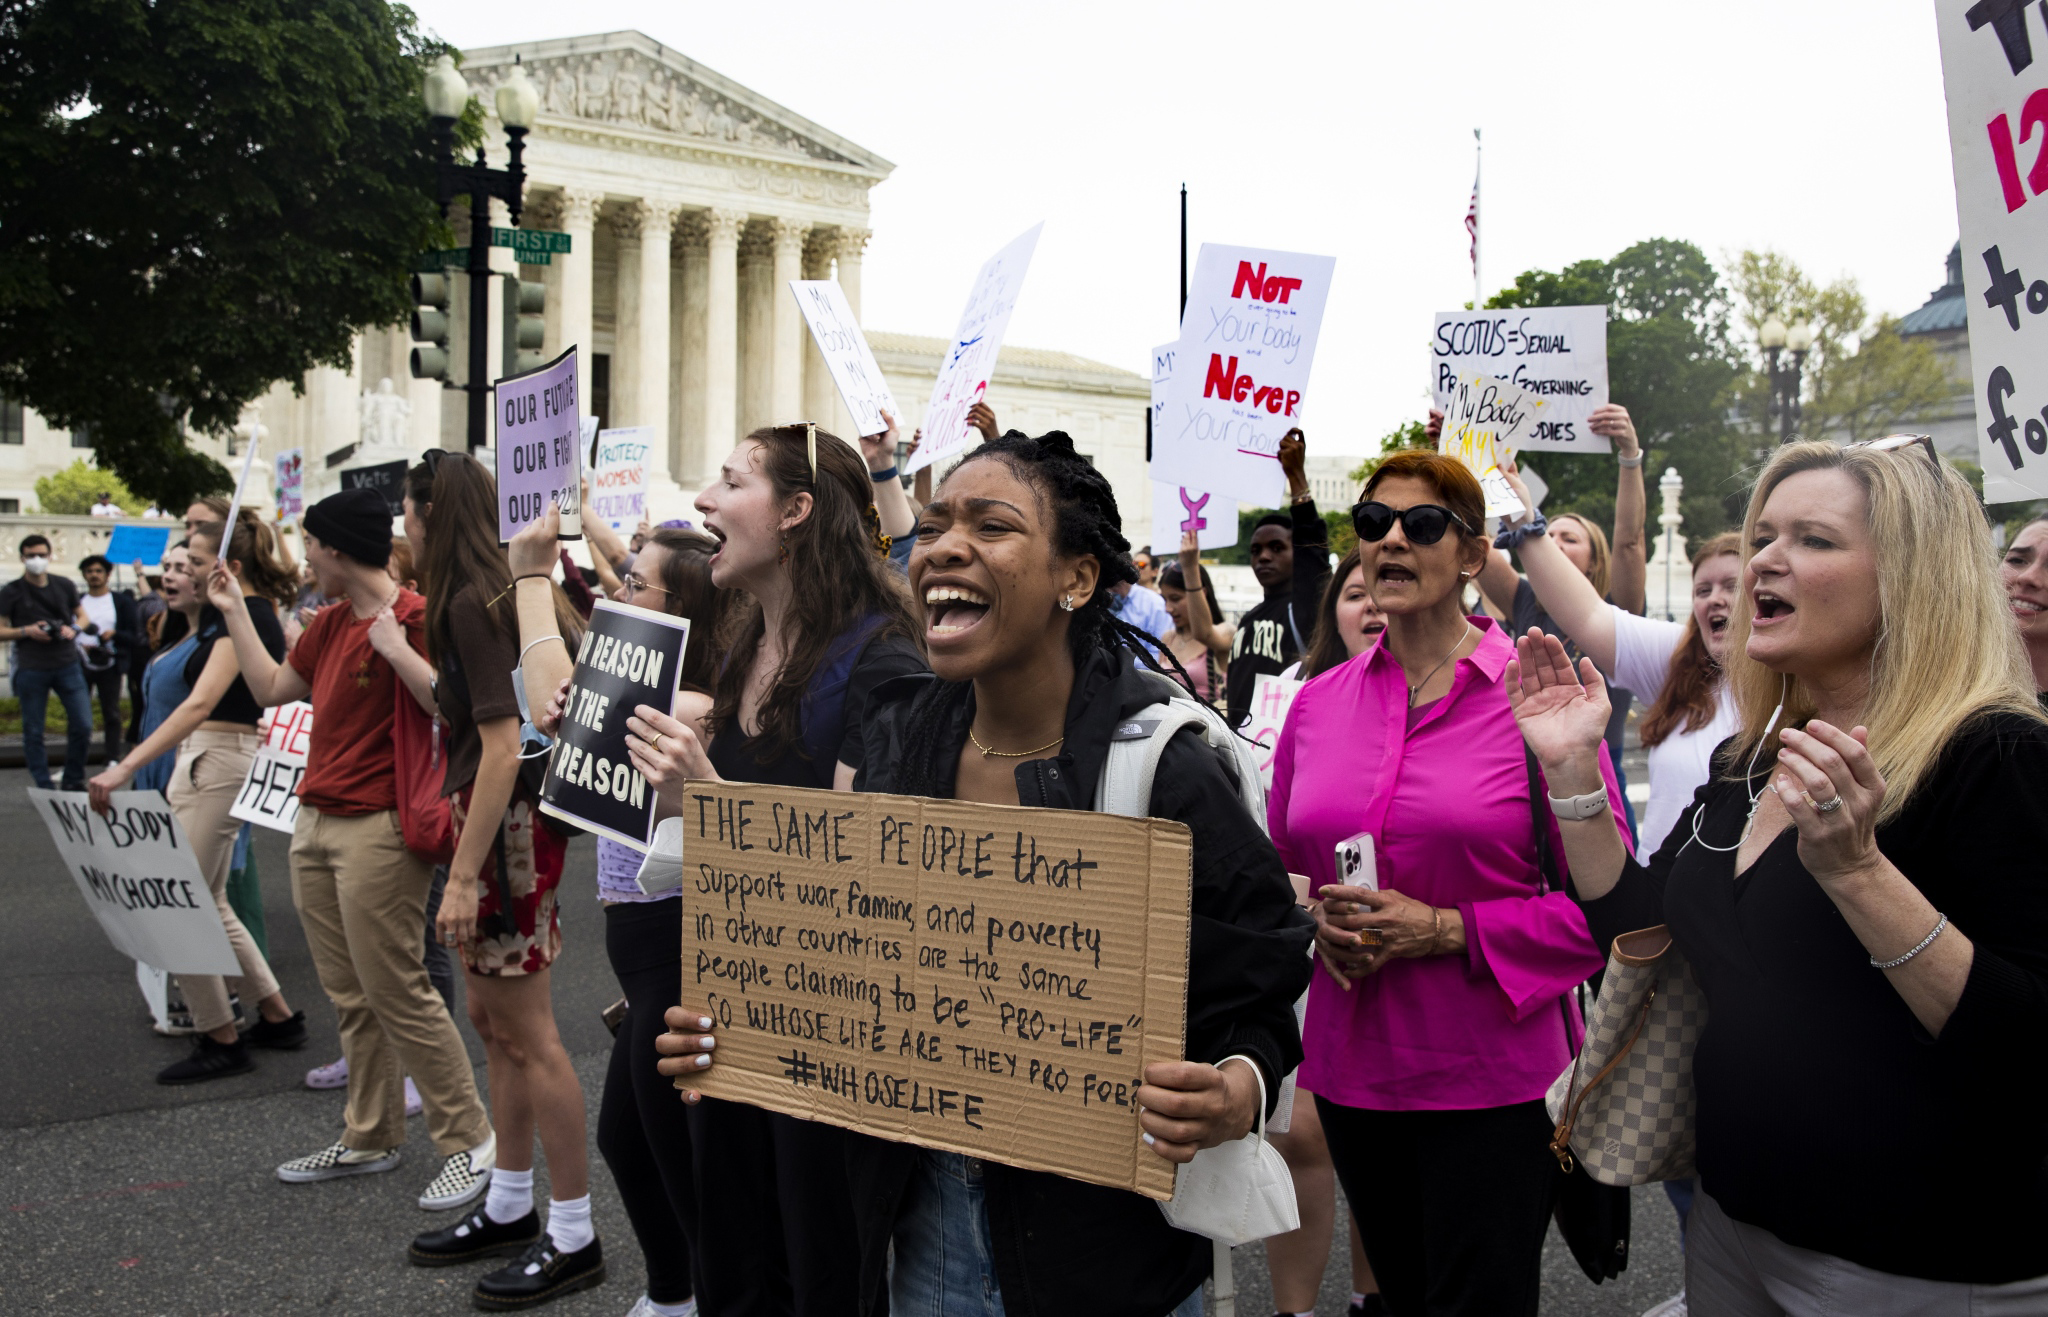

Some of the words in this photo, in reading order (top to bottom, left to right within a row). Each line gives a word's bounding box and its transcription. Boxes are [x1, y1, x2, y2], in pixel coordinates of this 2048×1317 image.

[497, 230, 553, 249] FIRST
[514, 252, 549, 263] UNIT
[1982, 244, 2048, 332] to
[1261, 315, 1301, 365] body
[505, 393, 537, 427] OUR
[544, 374, 574, 418] FUTURE
[1475, 385, 1525, 442] Body
[513, 441, 547, 474] OUR
[599, 442, 649, 467] PROTECT
[1237, 422, 1281, 454] Choic
[508, 492, 542, 523] OUR
[589, 633, 664, 689] REASON
[575, 688, 610, 733] THE
[555, 742, 646, 810] REASON
[49, 798, 94, 846] MY
[102, 805, 177, 849] BODY
[691, 794, 754, 851] THE
[768, 802, 855, 864] SAME
[880, 815, 994, 878] PEOPLE
[1011, 831, 1098, 890] that
[112, 873, 200, 911] CHOICE
[695, 905, 714, 941] in
[725, 911, 786, 948] other
[797, 927, 902, 961] countries
[919, 945, 947, 968] are
[959, 947, 1000, 982] the
[1019, 962, 1092, 1000] same
[797, 883, 841, 918] war,
[926, 901, 975, 934] and
[987, 917, 1101, 969] poverty
[890, 974, 916, 1012] to
[933, 984, 970, 1028] be
[707, 992, 732, 1029] SO
[746, 1000, 833, 1044] WHOSE
[839, 1017, 886, 1052] LIFE
[900, 1028, 942, 1062] ARE
[955, 1044, 1017, 1078] THEY
[1029, 1058, 1069, 1094] PRO
[777, 1048, 984, 1131] #WHOSELIFE
